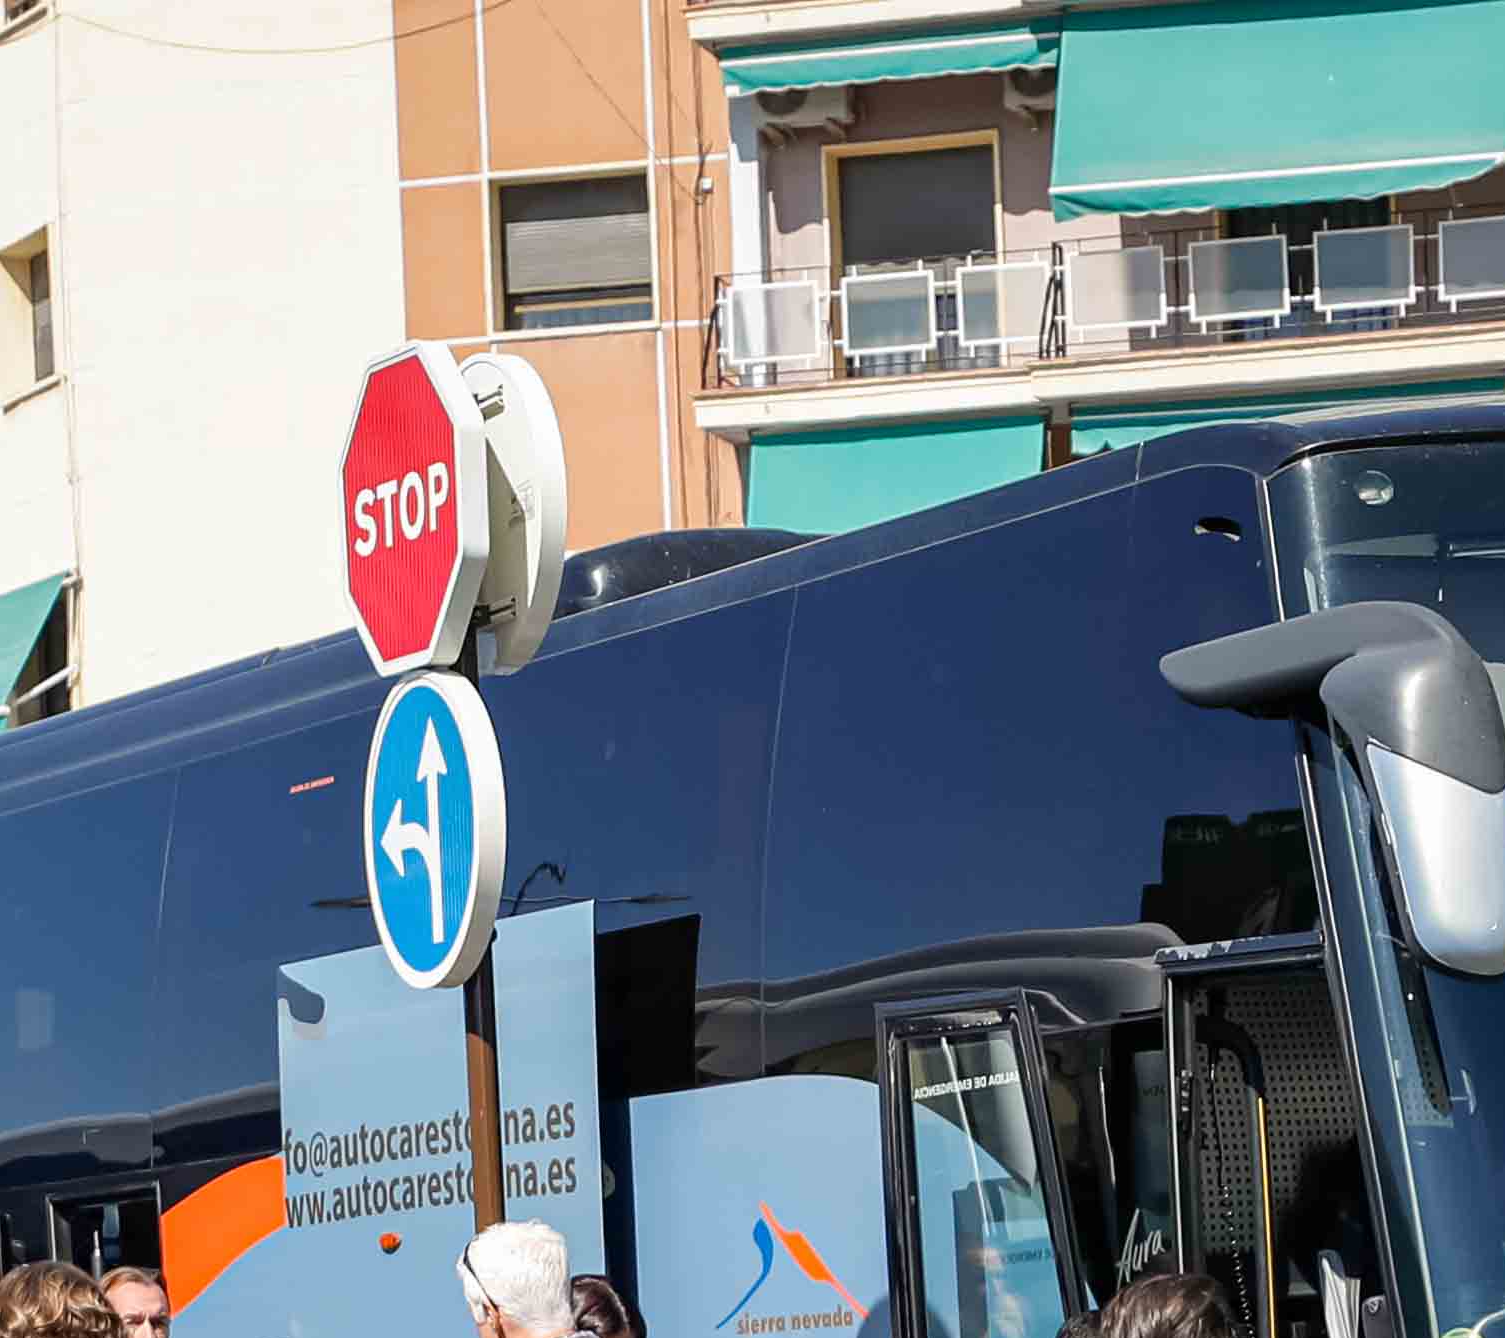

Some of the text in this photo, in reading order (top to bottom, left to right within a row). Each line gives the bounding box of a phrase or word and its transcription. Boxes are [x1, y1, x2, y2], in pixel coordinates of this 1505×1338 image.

[354, 462, 449, 557] STOP
[1115, 1207, 1166, 1290] Aura
[736, 1304, 853, 1336] sierra nevada
